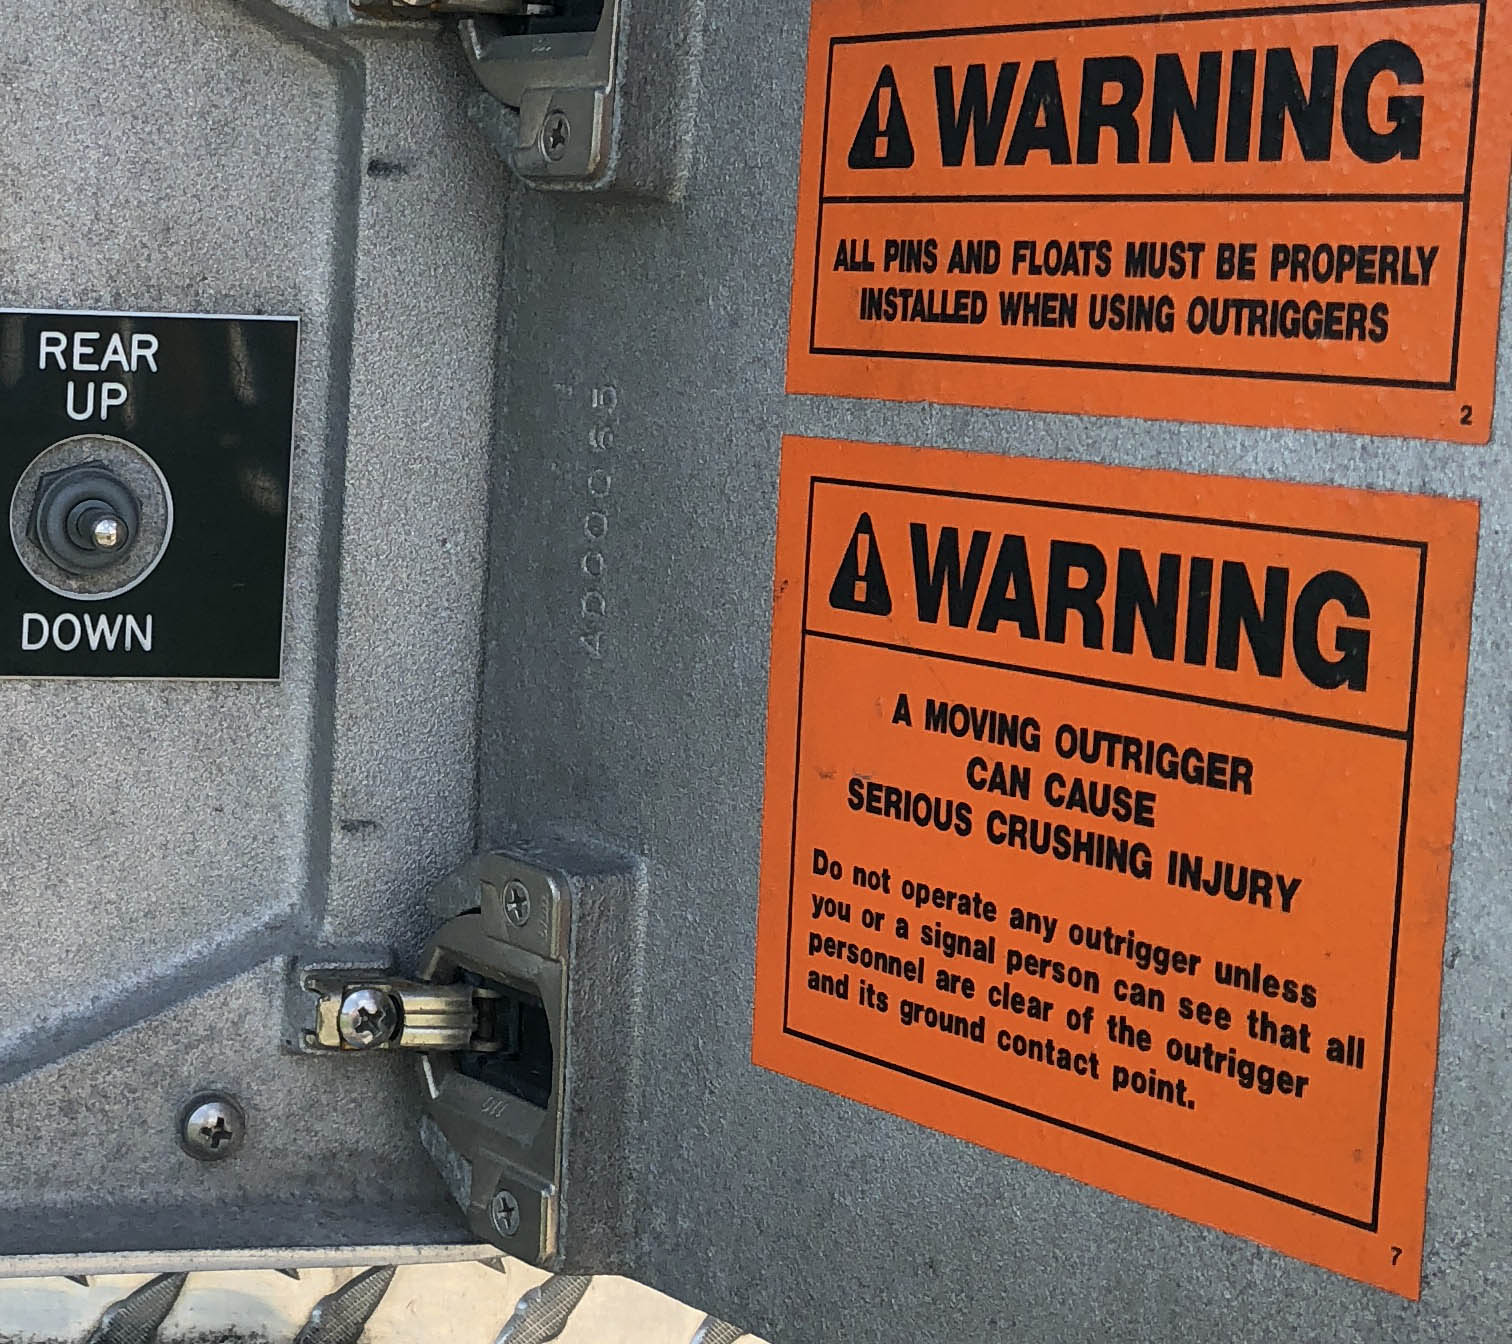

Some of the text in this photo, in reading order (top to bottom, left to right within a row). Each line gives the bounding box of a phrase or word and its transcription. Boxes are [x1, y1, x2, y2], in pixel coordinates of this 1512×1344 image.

[933, 38, 1425, 168] WARNING
[832, 238, 1440, 286] ALL PINS AND FLOATS MUST BE PROPERLY
[39, 331, 159, 372] REAR
[859, 286, 1389, 344] INSTALLED WHEN USING OUTRIGGERS
[66, 381, 128, 421] UP
[1460, 404, 1473, 426] 2
[21, 612, 153, 651] DOWN
[909, 522, 1371, 693] WARNING
[891, 693, 1254, 796] A MOVING OUTRIGGER
[966, 756, 1157, 828] CAN CAUSE
[847, 777, 1303, 913] SERIOUS CRUSHING INJURY
[812, 847, 1317, 1009] Do not operate any outrigger unless
[808, 931, 1310, 1098] personnel are clear of the outrigger
[811, 893, 1365, 1070] you or a signal person can see that all
[807, 970, 1195, 1110] and its ground contact point.
[1391, 1246, 1403, 1266] 7
